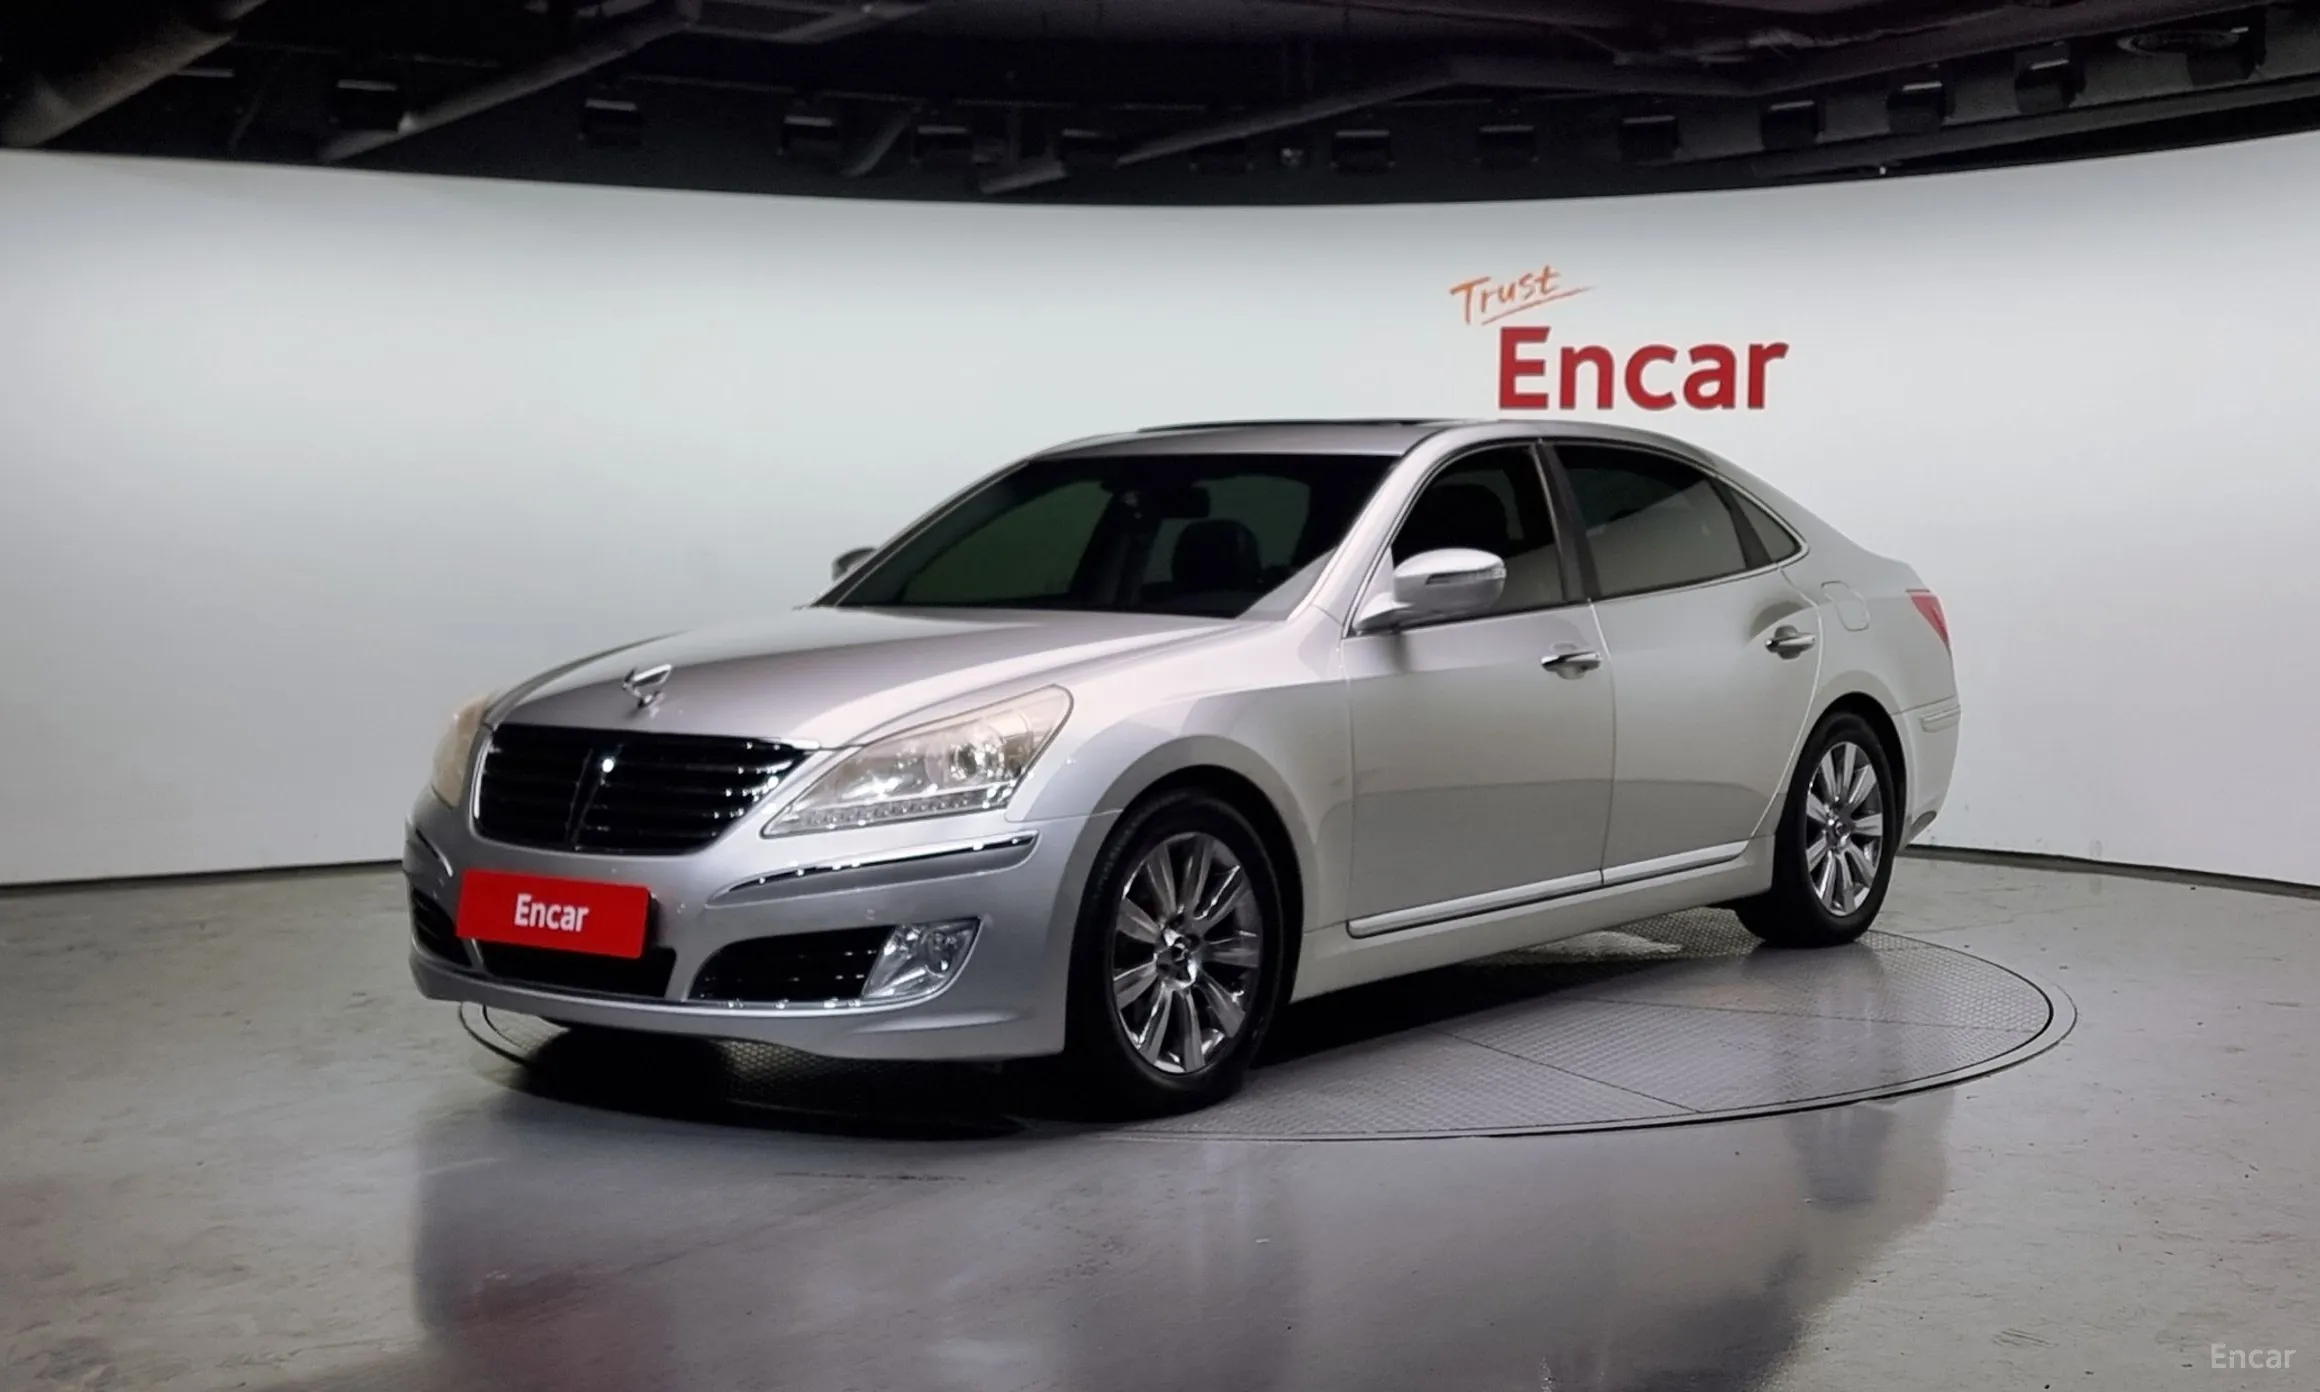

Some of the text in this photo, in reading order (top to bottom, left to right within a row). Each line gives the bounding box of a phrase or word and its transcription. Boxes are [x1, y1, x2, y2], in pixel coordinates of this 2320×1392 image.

[1450, 264, 1561, 325] Trust
[1498, 325, 1790, 410] Encar
[514, 893, 590, 932] Encar
